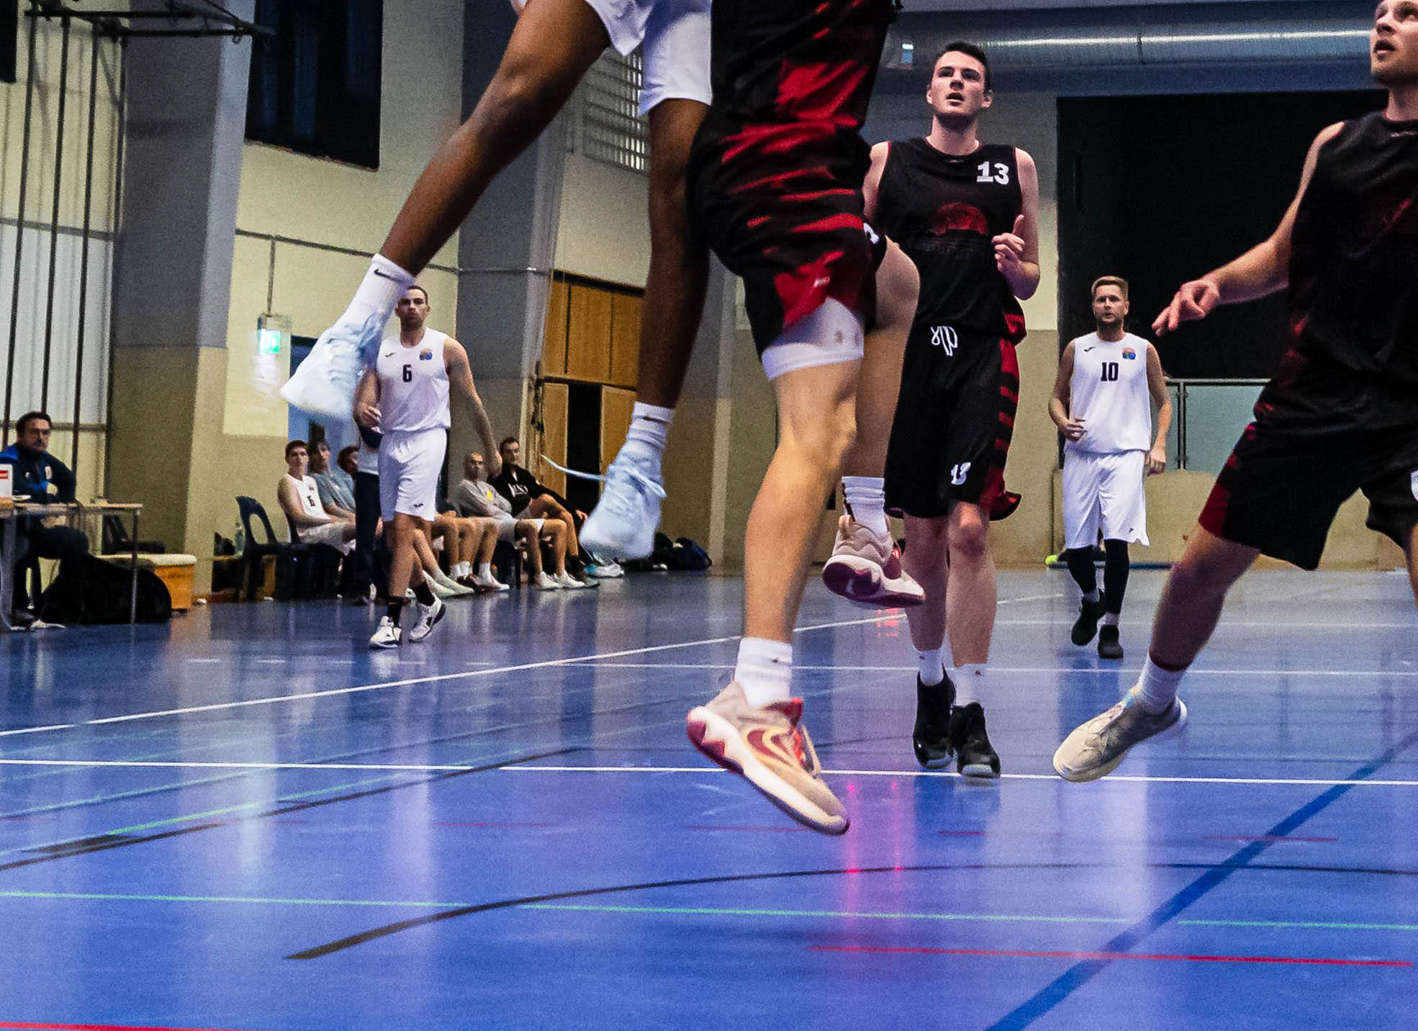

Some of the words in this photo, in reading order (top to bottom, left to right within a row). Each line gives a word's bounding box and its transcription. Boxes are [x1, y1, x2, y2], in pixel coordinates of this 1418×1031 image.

[976, 162, 1010, 185] 13
[402, 364, 413, 383] 6
[1100, 362, 1119, 382] 10
